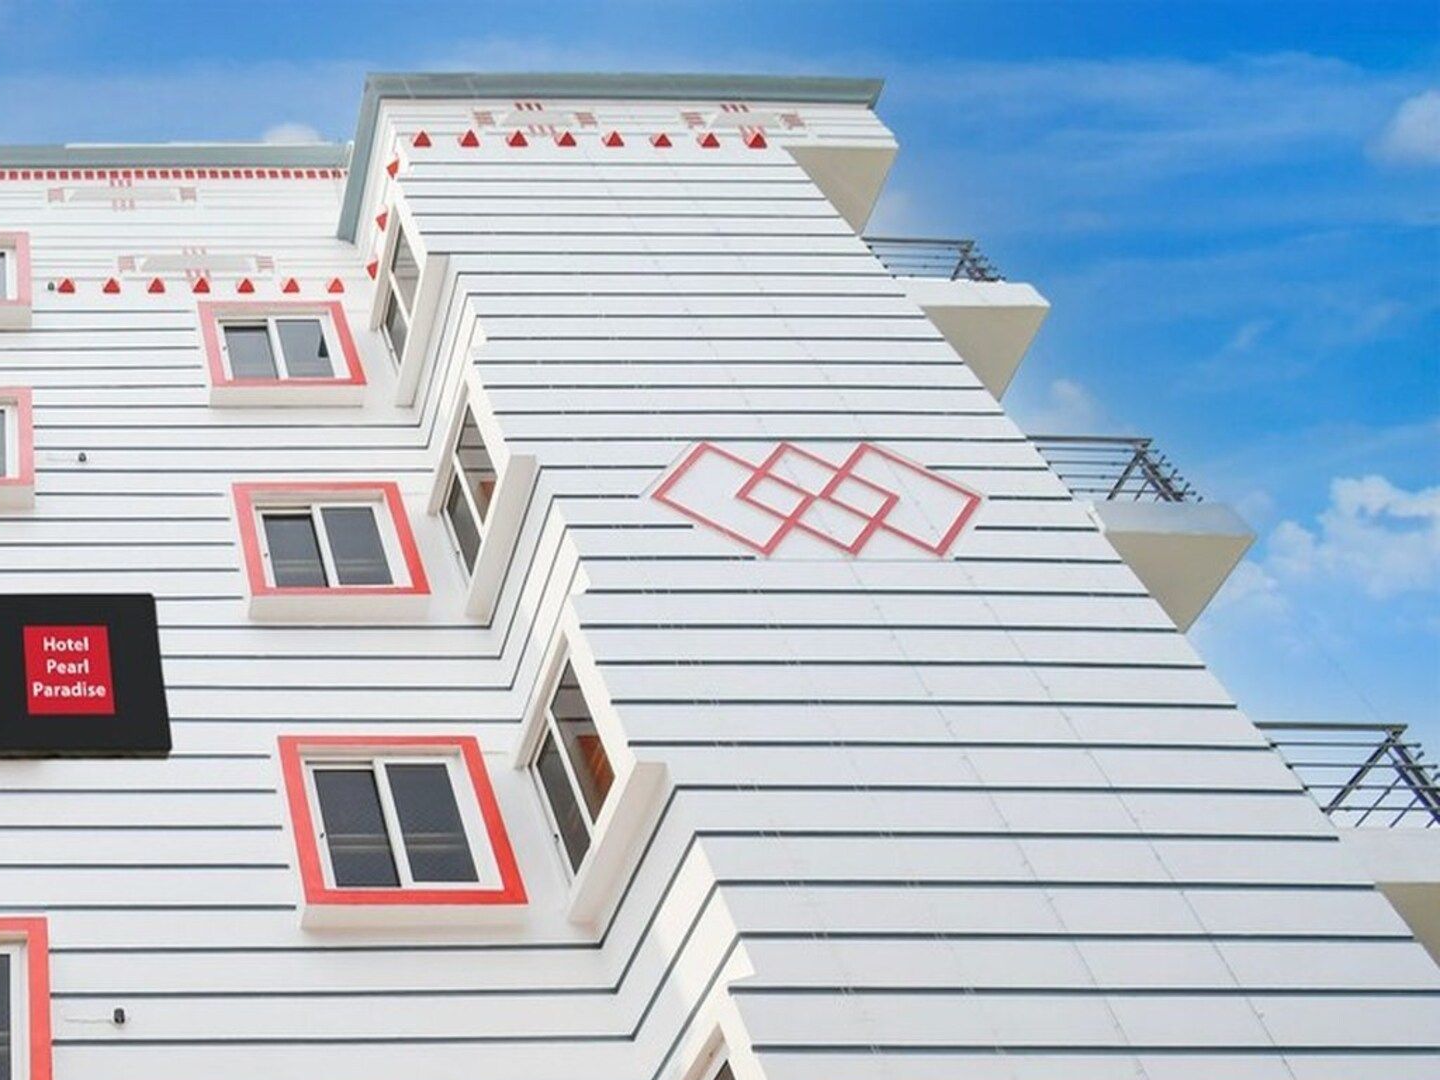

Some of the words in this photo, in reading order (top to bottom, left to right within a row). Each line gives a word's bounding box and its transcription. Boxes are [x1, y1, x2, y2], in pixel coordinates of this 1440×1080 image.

[43, 636, 90, 652] Hotel
[46, 658, 90, 674] Pearl
[32, 681, 107, 697] Paradise
